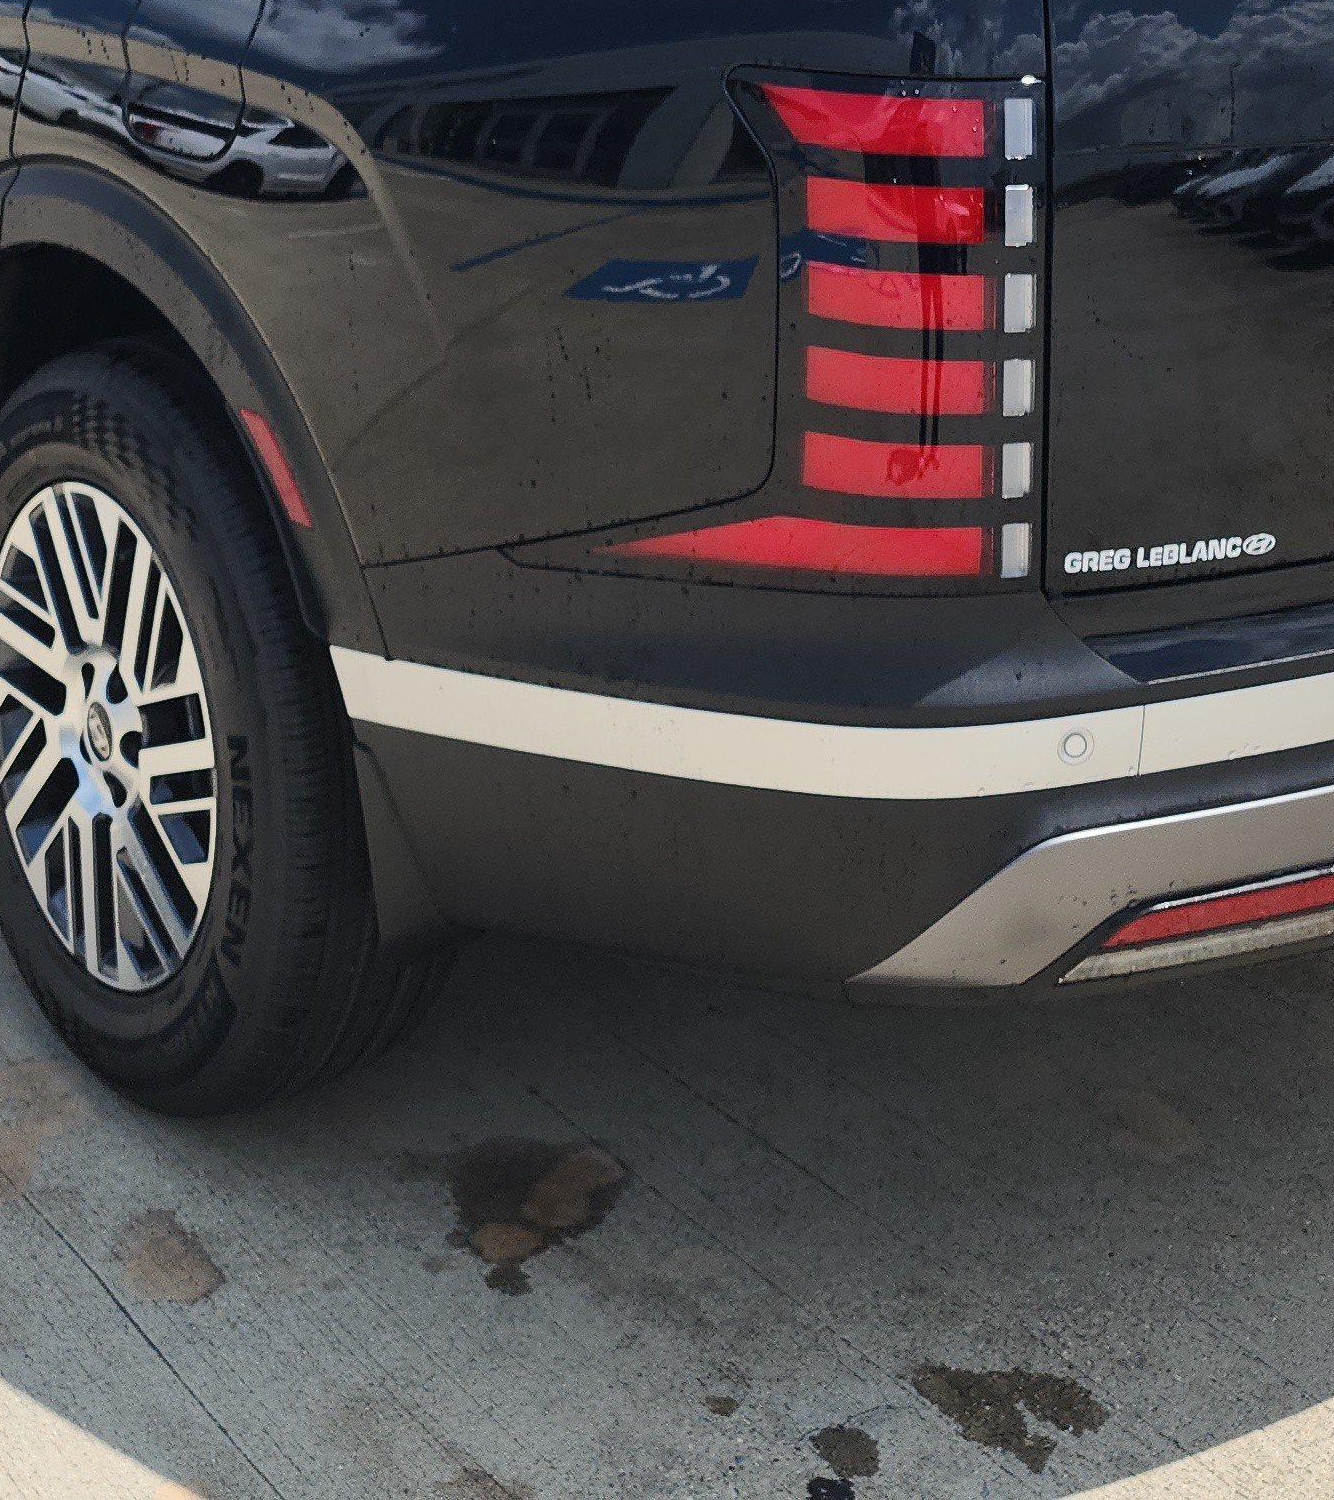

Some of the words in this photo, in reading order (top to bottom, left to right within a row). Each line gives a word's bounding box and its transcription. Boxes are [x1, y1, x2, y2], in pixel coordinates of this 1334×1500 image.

[1064, 548, 1131, 574] GREG
[1136, 536, 1242, 568] LEBLANC
[221, 735, 254, 967] NEXEN
